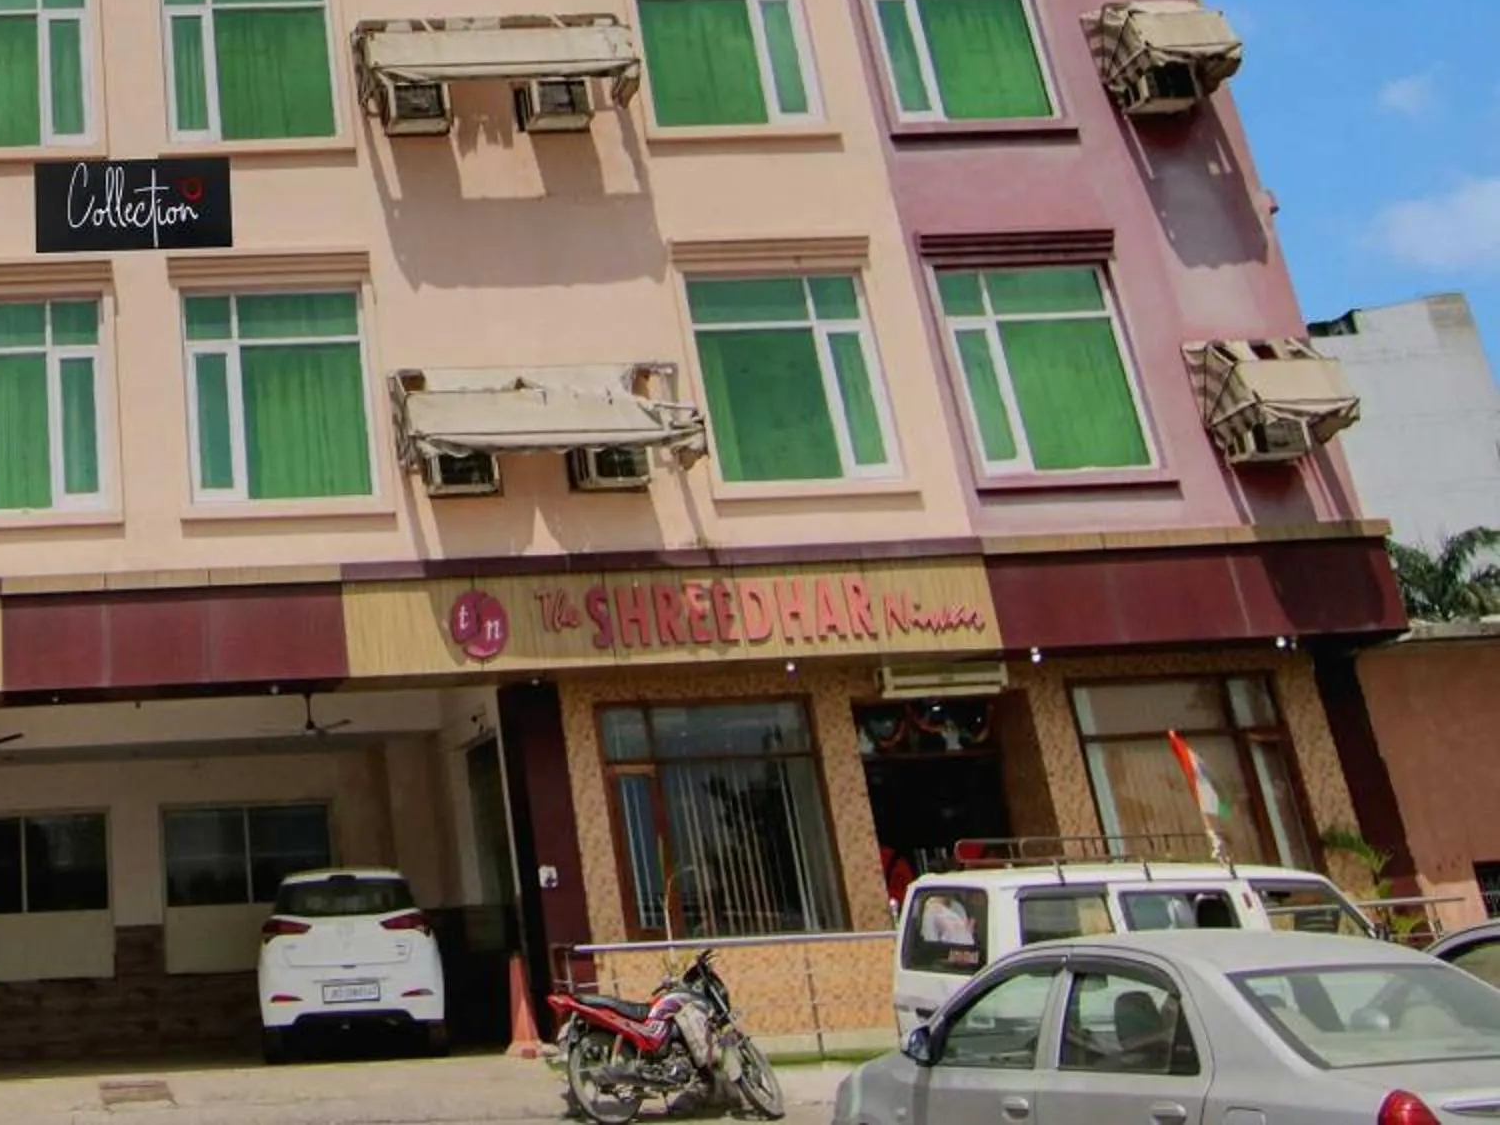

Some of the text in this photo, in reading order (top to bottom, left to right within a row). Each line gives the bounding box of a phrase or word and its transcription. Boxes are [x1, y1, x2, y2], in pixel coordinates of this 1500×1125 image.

[67, 162, 199, 247] Collection
[534, 586, 582, 632] The
[585, 577, 878, 649] SHREEDHAR
